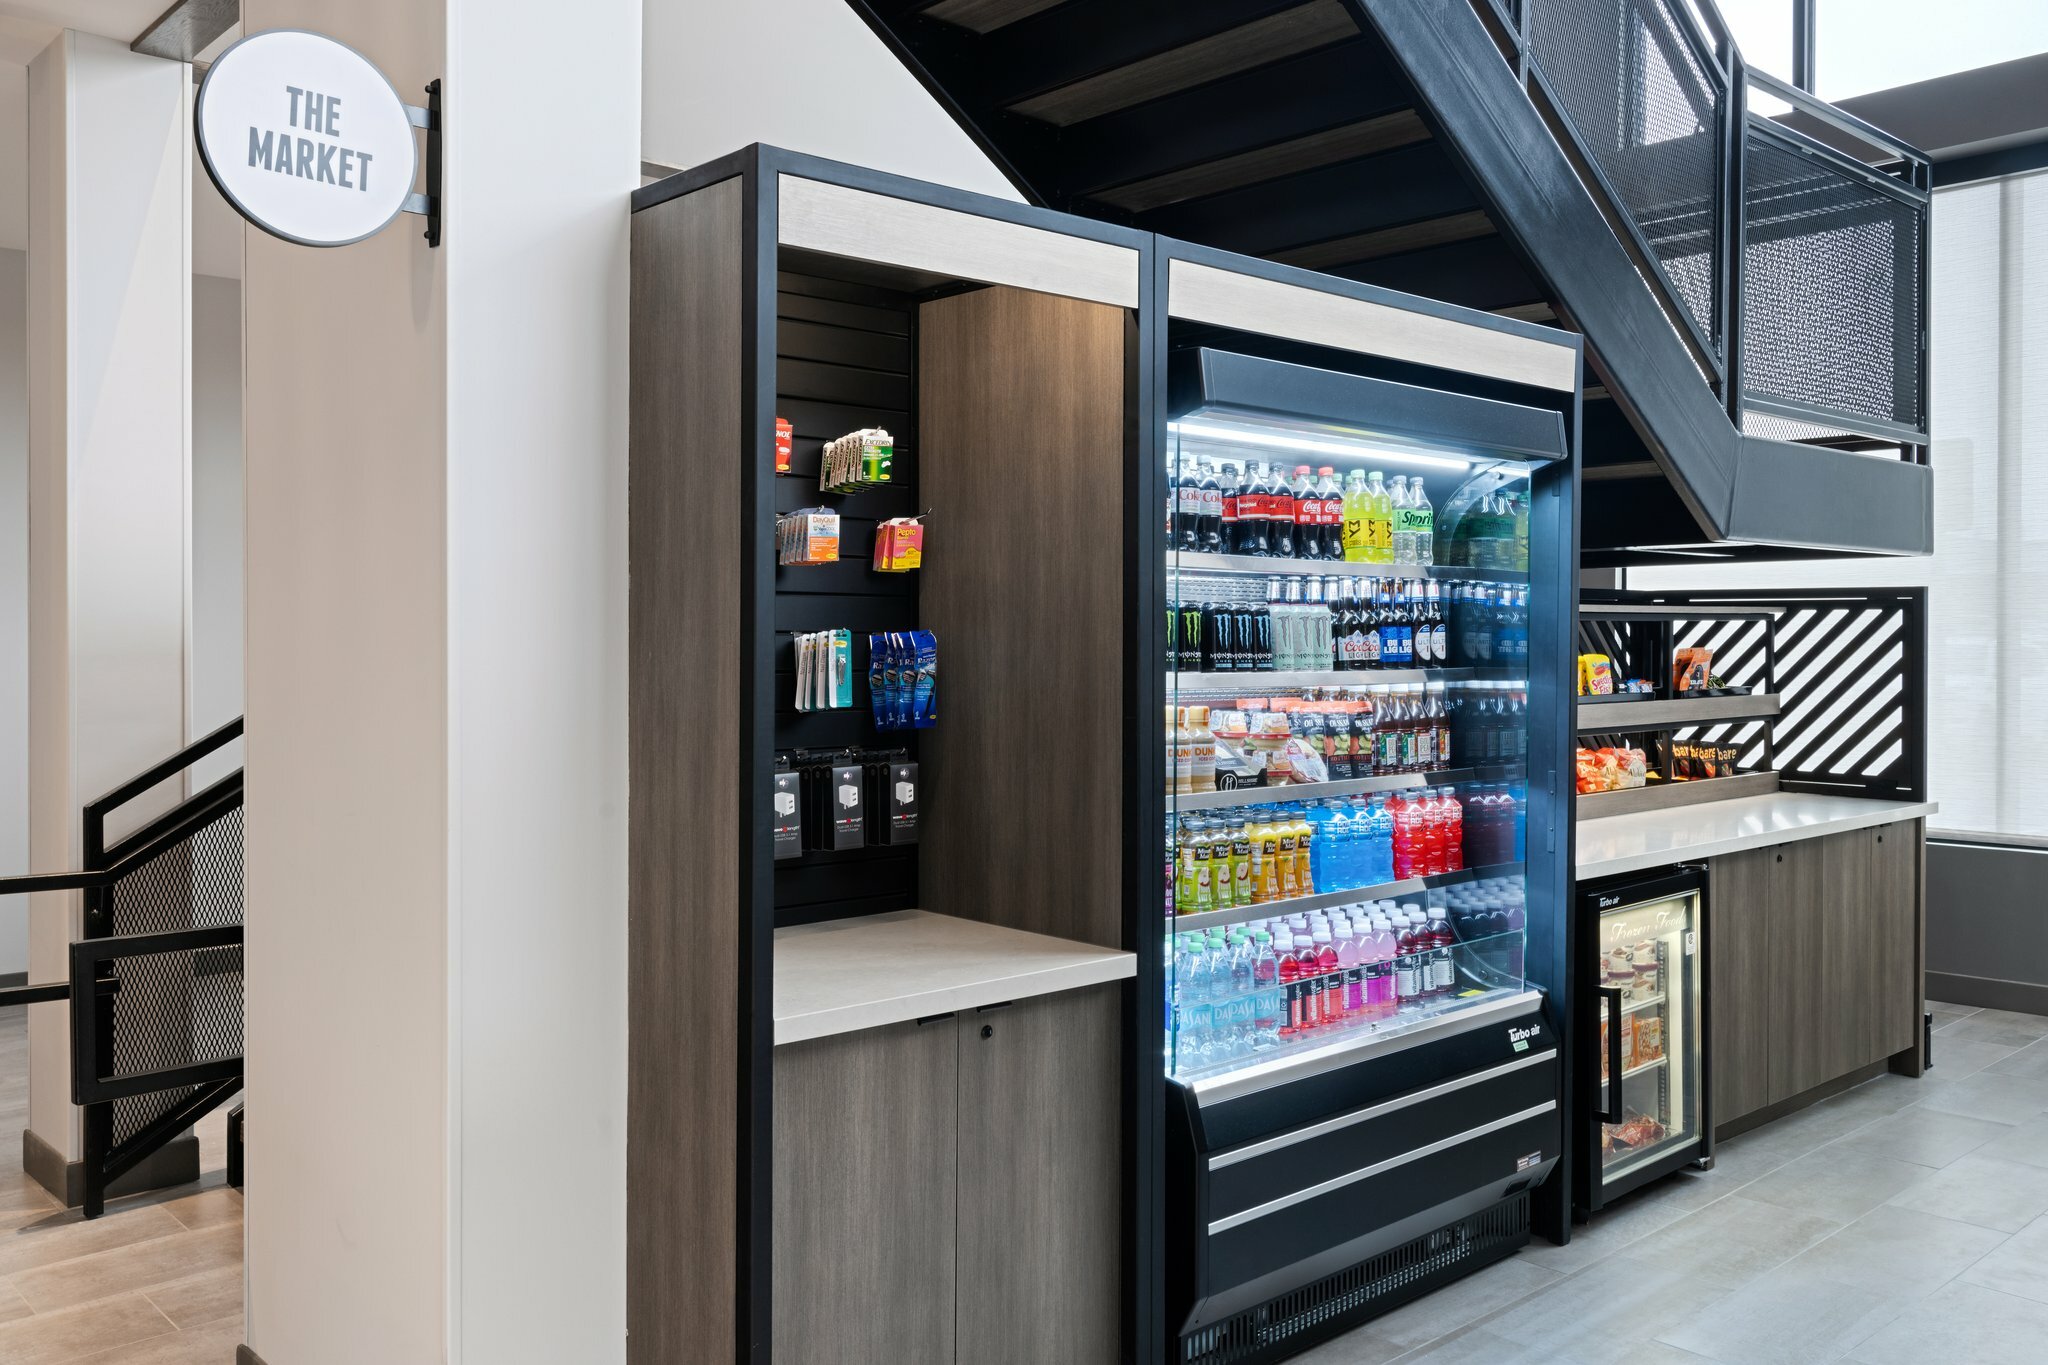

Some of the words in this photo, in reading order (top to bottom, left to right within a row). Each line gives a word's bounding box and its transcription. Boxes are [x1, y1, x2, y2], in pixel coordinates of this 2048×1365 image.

[286, 85, 341, 137] THE
[248, 126, 373, 192] MARKET
[897, 528, 916, 537] Pepto
[1699, 746, 1716, 759] bare
[1717, 748, 1736, 760] bare
[1600, 897, 1612, 908] Turbo
[1611, 922, 1650, 942] Frozen
[1508, 1028, 1530, 1042] Turbo
[1530, 1024, 1540, 1036] air
